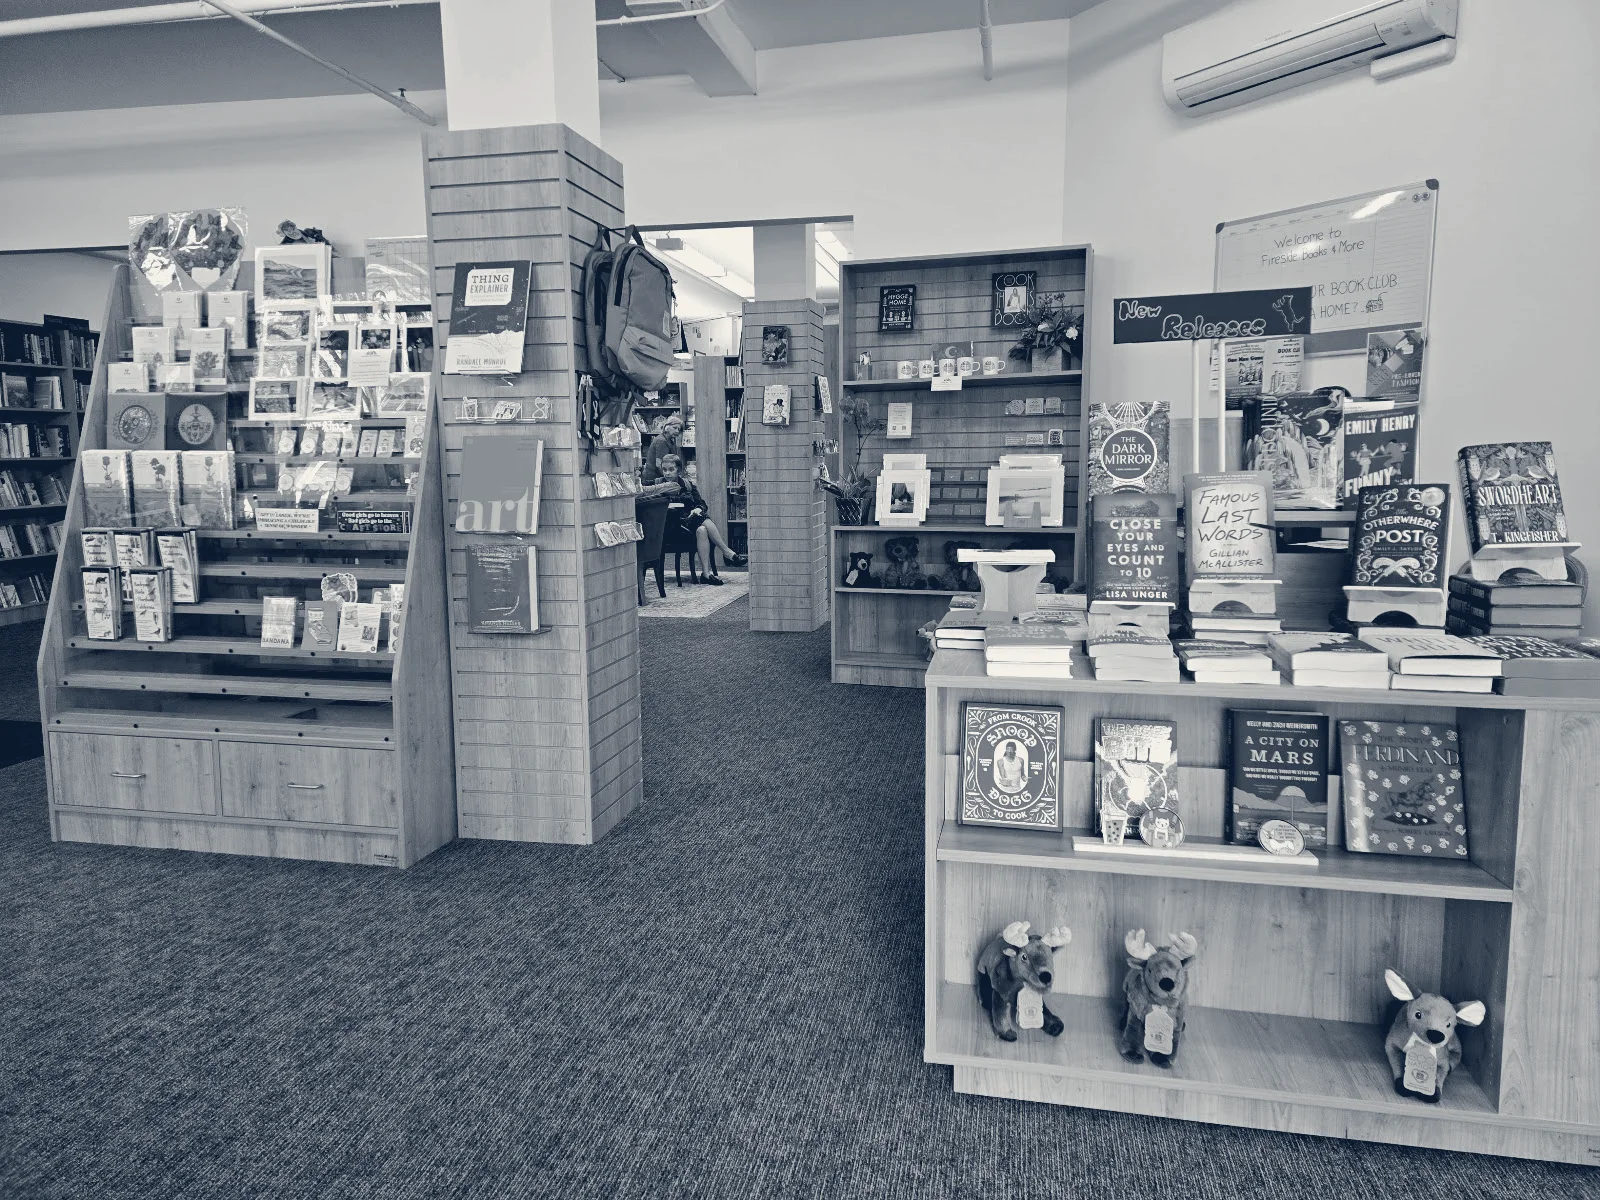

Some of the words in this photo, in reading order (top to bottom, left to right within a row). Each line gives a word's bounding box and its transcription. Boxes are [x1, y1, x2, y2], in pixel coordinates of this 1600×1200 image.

[1273, 232, 1324, 249] Welcome
[1328, 226, 1342, 239] to
[1261, 250, 1298, 267] Fireside
[1302, 246, 1328, 261] Books
[1338, 239, 1365, 254] More
[471, 274, 510, 284] THING
[1330, 277, 1365, 297] BOOK
[1367, 273, 1398, 291] CLUB
[470, 283, 509, 294] EXPLAINER
[1118, 300, 1162, 321] New
[1161, 313, 1267, 340] Releases
[1345, 419, 1378, 435] EMILY
[1381, 414, 1416, 432] HENRY
[1112, 443, 1146, 454] DARK
[1104, 454, 1152, 465] MIRROR
[1345, 466, 1394, 498] FUNNY
[1199, 488, 1260, 507] FAMOUS
[1478, 483, 1558, 507] SWORDHEART
[455, 486, 536, 533] art
[1201, 506, 1260, 524] LAST
[1109, 518, 1162, 530] CLOSE
[1363, 515, 1440, 531] OTHERWHERE
[1117, 532, 1154, 541] YOUR
[1198, 525, 1263, 542] WORDS
[1375, 529, 1425, 543] POST
[1490, 532, 1502, 543] T.
[1504, 530, 1560, 543] KINGFISHER
[1107, 543, 1139, 552] EYES
[1209, 548, 1250, 558] GILLIAN
[1107, 555, 1165, 566] COUNT
[1120, 569, 1133, 577] TO
[1136, 567, 1152, 578] 10
[1105, 590, 1128, 598] LISA
[1132, 591, 1168, 599] UNGER
[987, 712, 1010, 725] FROM
[1011, 713, 1037, 727] CROOK
[986, 725, 1037, 748] SNOOP
[1244, 735, 1255, 745] A
[1258, 736, 1295, 747] CITY
[1299, 738, 1320, 748] ON
[1249, 749, 1314, 765] MARS
[1350, 744, 1460, 766] FERDINAND
[987, 786, 1032, 807] DOGG
[993, 808, 1004, 818] TO
[1005, 810, 1028, 820] COOK
